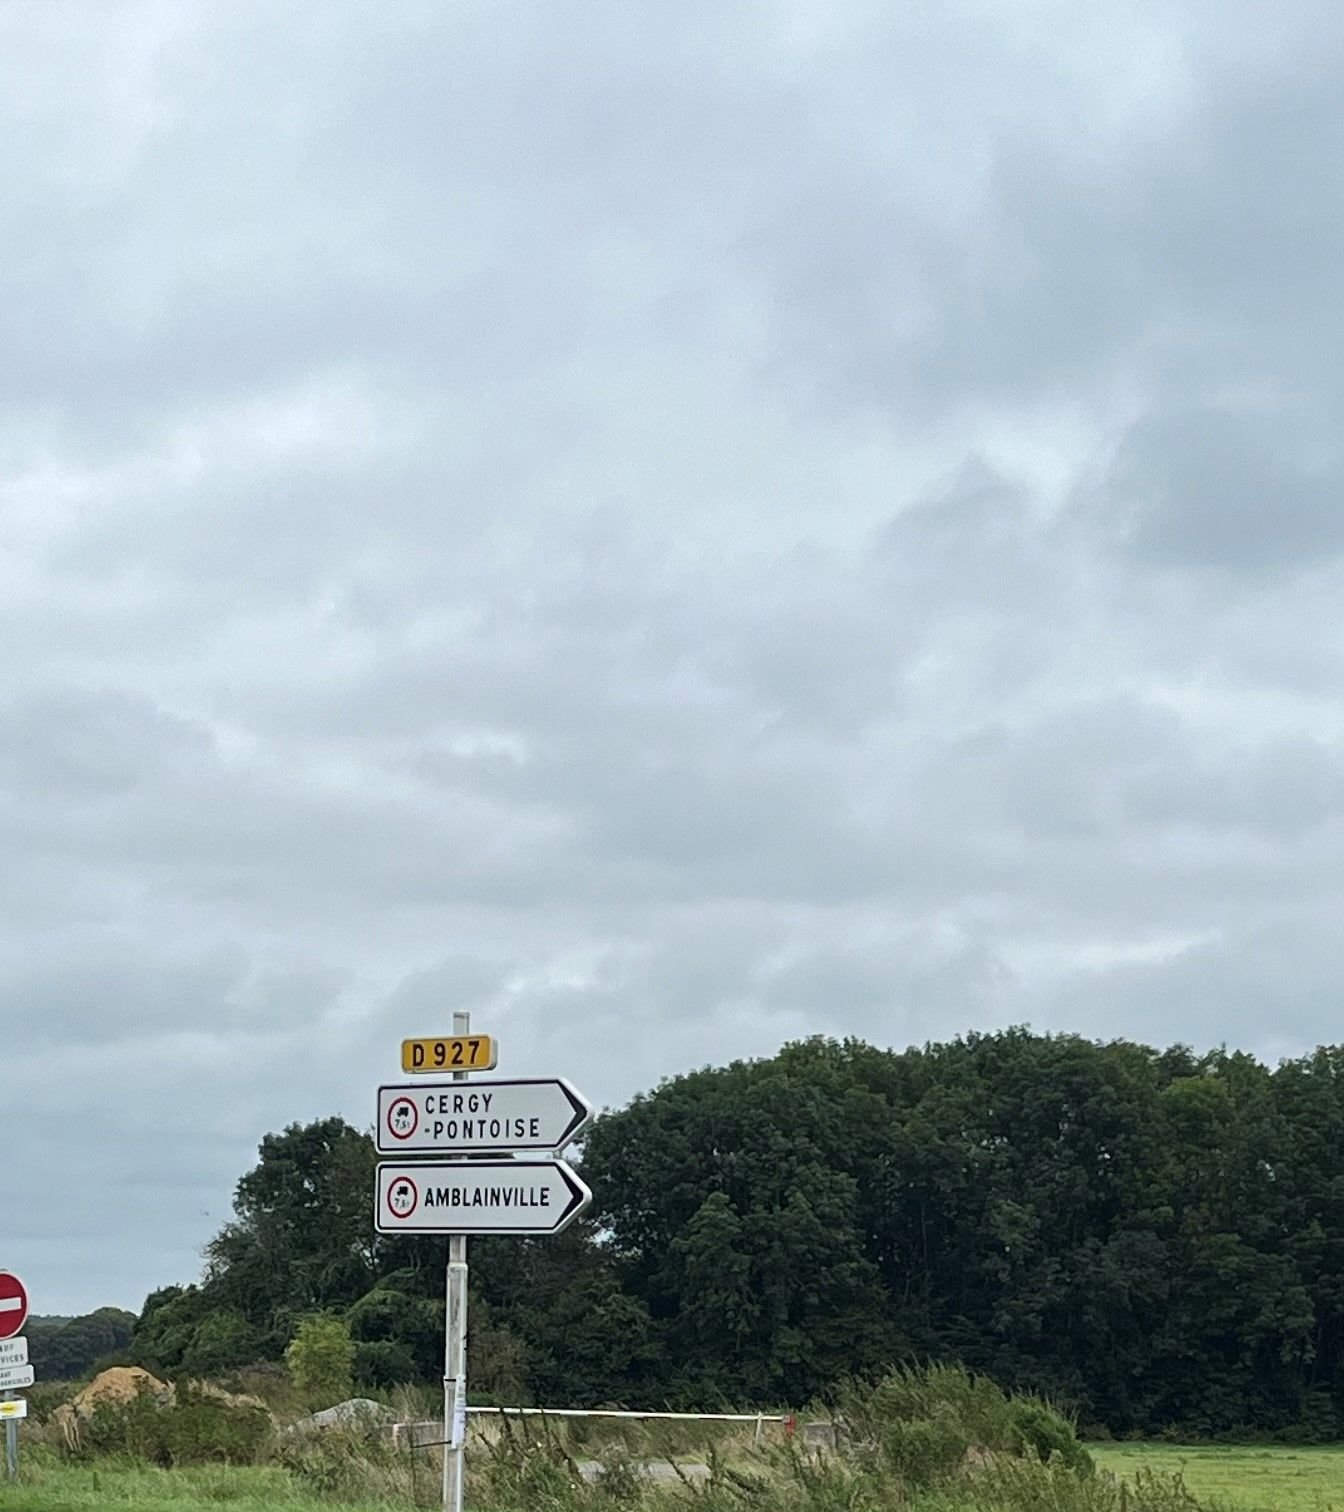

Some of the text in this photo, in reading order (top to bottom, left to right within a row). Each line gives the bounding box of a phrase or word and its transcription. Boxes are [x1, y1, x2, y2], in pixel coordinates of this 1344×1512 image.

[412, 1040, 480, 1067] D 927
[425, 1093, 493, 1115] CERGY
[424, 1117, 540, 1140] -PONTOISE
[423, 1186, 550, 1207] AMBLAINVILLE
